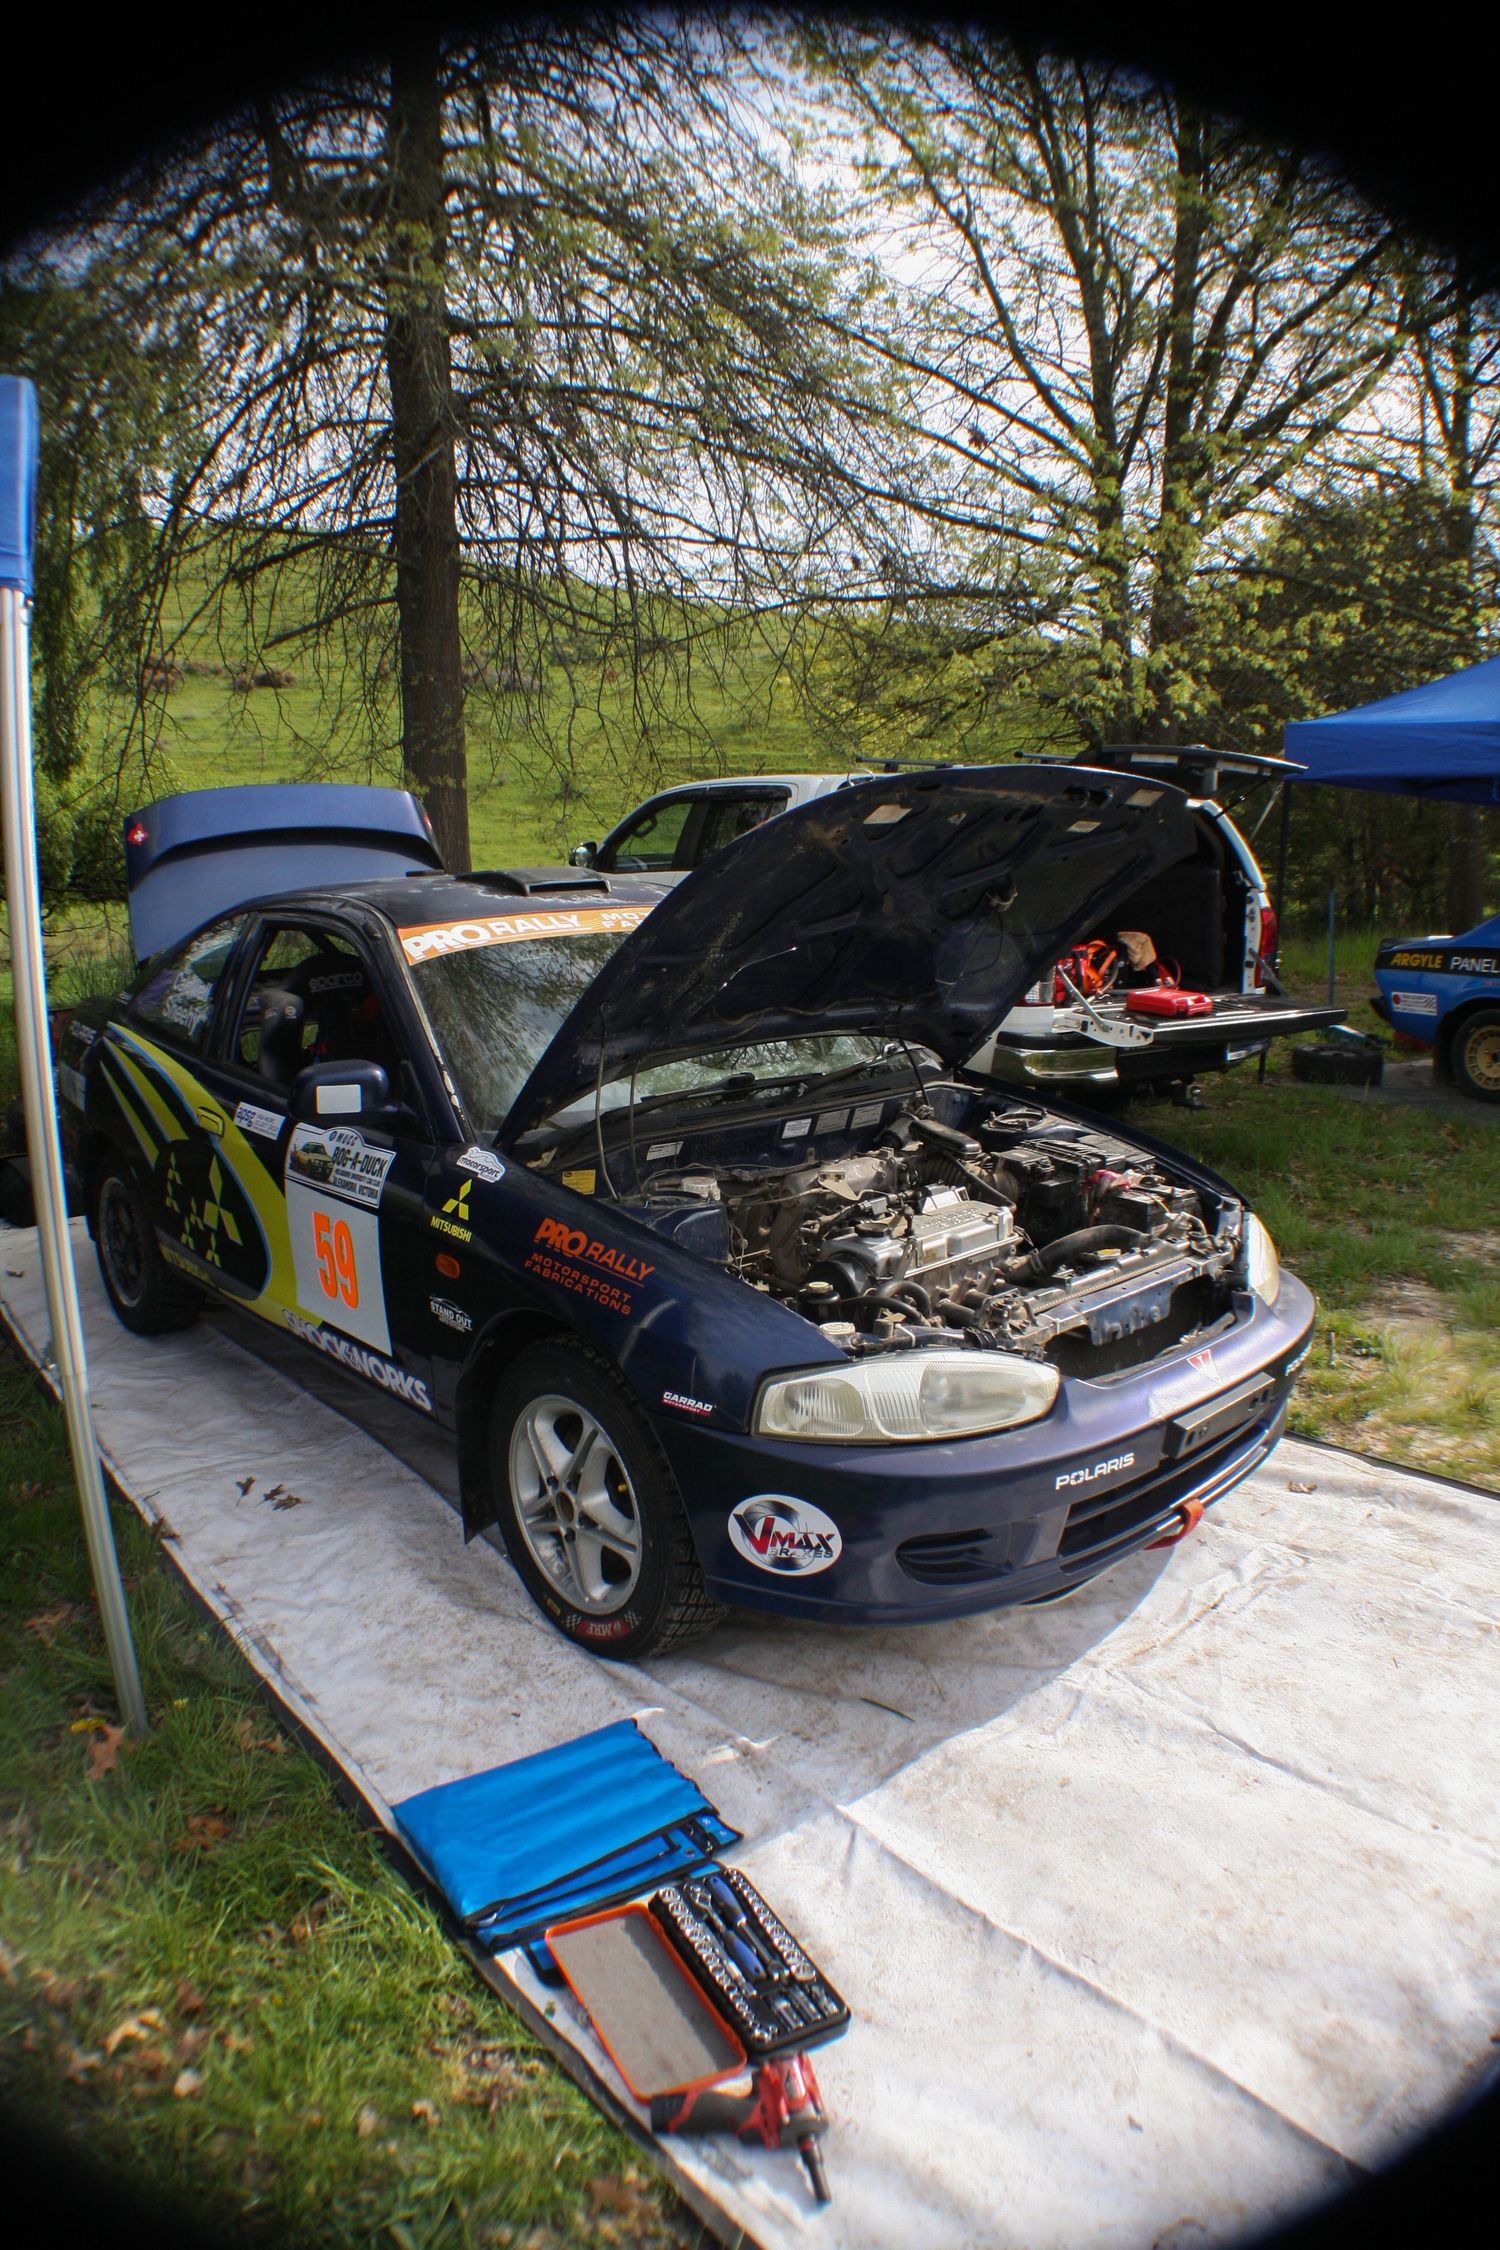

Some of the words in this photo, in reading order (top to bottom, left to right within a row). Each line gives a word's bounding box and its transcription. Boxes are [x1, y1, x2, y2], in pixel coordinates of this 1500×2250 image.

[401, 925, 491, 960] PRO
[488, 915, 583, 936] RALLY
[1390, 952, 1443, 969] ARGYLE
[1450, 956, 1500, 973] PANEL
[333, 1147, 388, 1178] BOG-A-DUCK
[459, 1157, 500, 1178] motorsport
[430, 1216, 472, 1242] MITSUBISHI
[312, 1211, 359, 1310] 59
[533, 1217, 588, 1258] PRO
[585, 1241, 656, 1281] RALLY
[524, 1260, 632, 1315] FABRICATIONS
[531, 1252, 632, 1303] MOTORSPORT
[431, 1301, 455, 1320] STAND
[455, 1313, 472, 1328] OUT
[663, 1391, 713, 1412] GARRAD
[1055, 1453, 1135, 1490] POLARIS
[733, 1513, 836, 1555] VMAX
[586, 1621, 613, 1637] MRF
